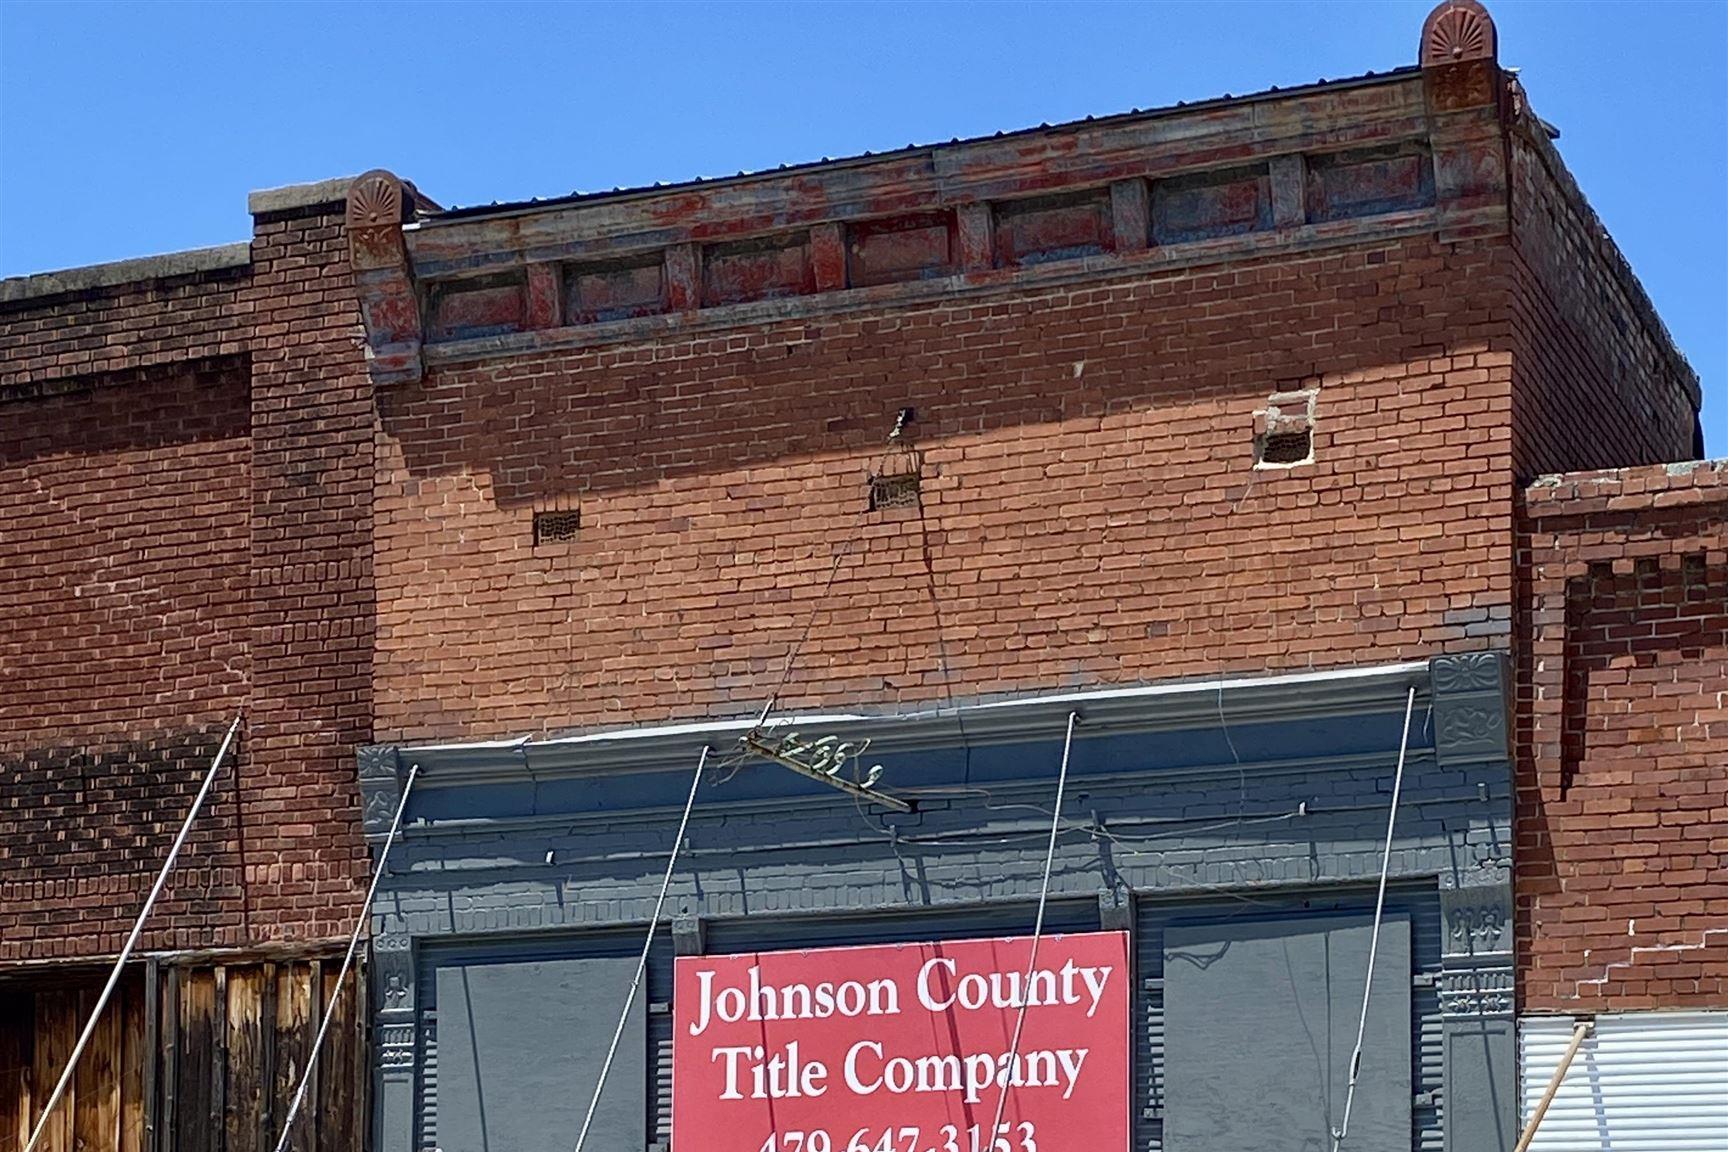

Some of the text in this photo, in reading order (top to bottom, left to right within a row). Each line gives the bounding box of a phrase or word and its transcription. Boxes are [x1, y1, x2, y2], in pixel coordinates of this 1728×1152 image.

[689, 957, 1113, 1036] Johnson County
[711, 1039, 1089, 1104] Title Company
